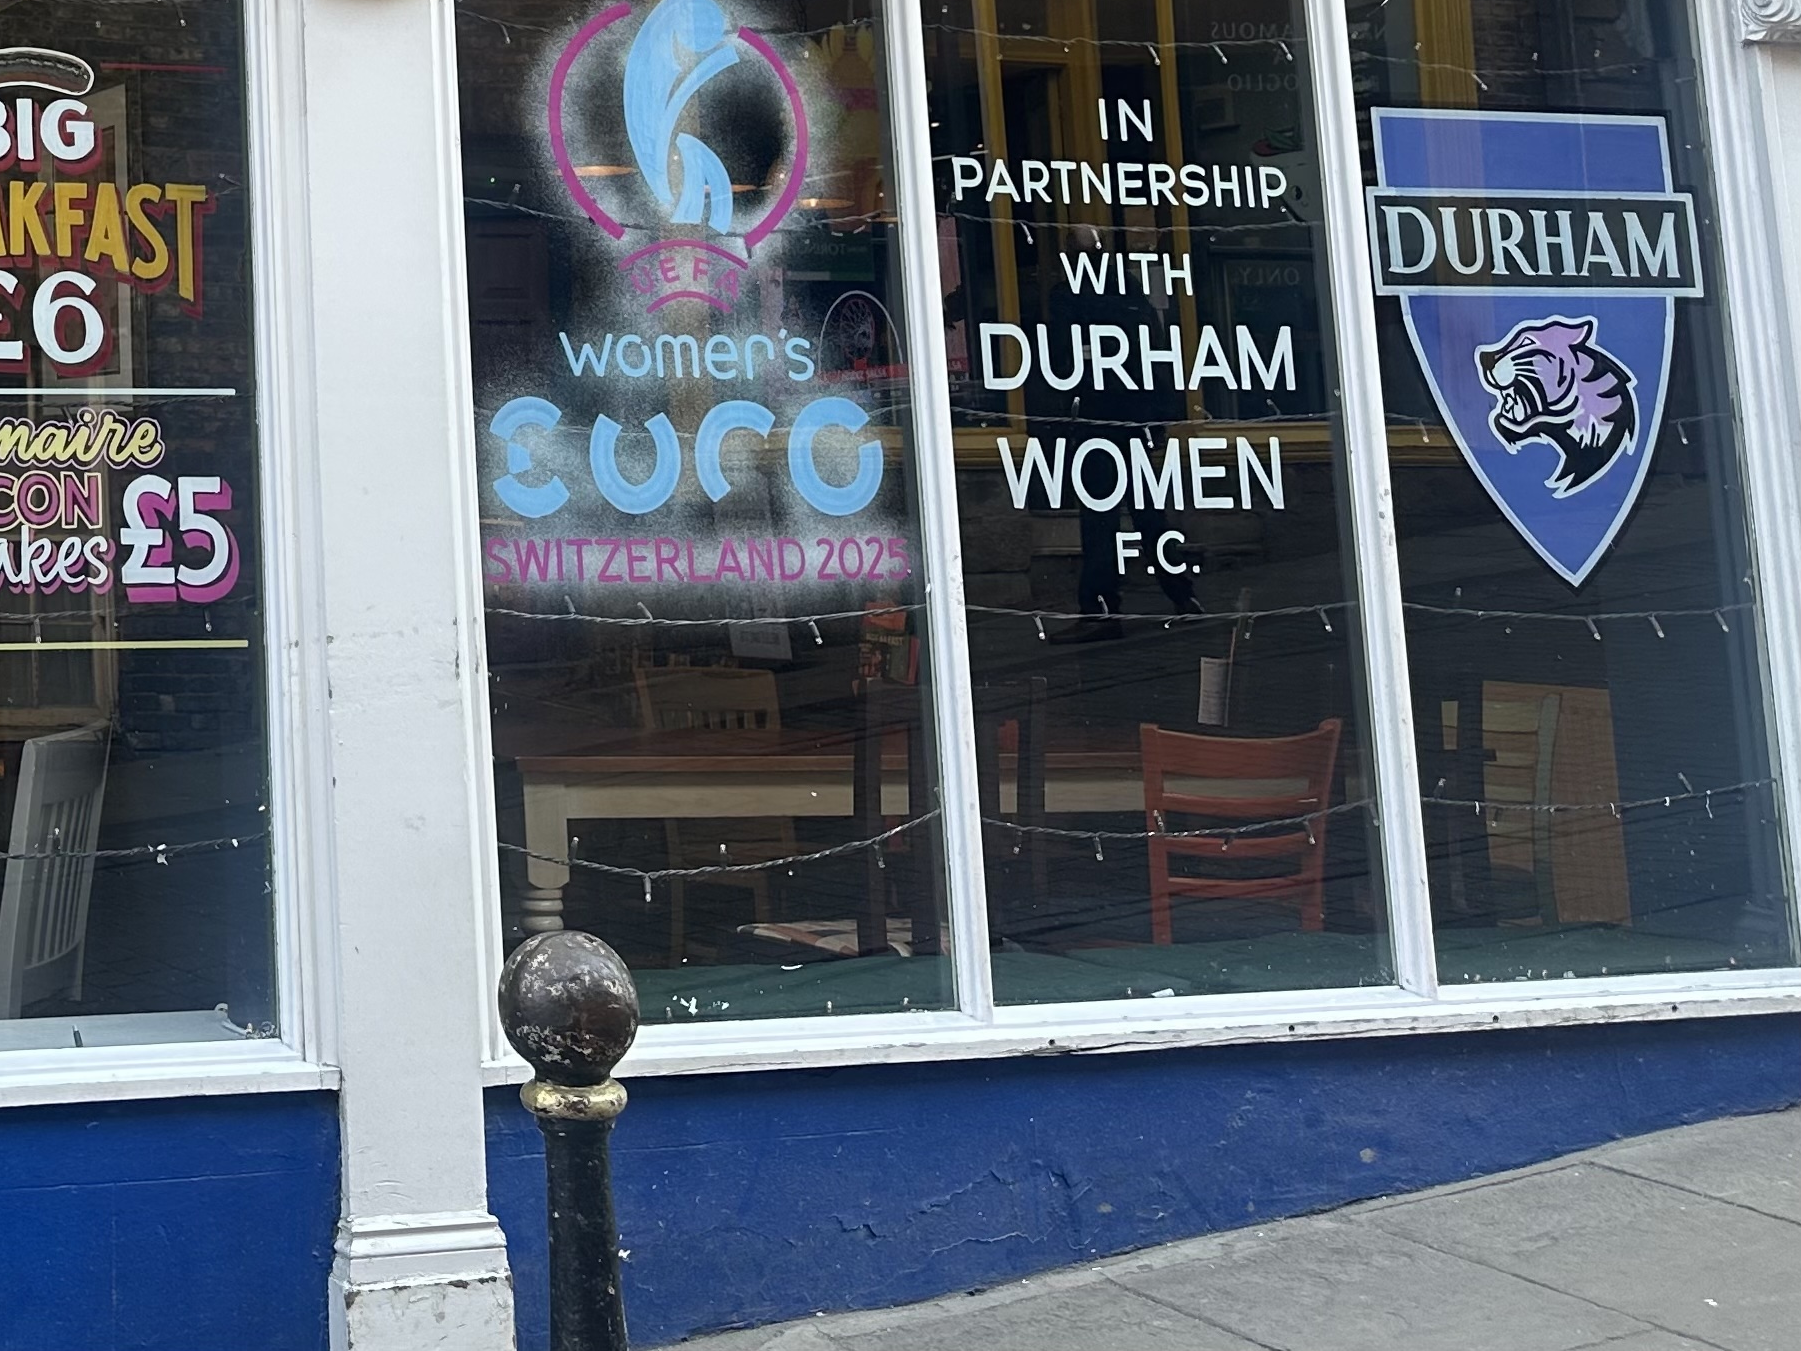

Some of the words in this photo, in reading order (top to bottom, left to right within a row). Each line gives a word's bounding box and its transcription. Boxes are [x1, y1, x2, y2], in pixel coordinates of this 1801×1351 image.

[1097, 98, 1153, 142] IN
[951, 156, 1288, 209] PARTNERSHIP
[1379, 205, 1681, 279] DURHAM
[629, 256, 739, 301] UEFA
[1059, 251, 1194, 296] WITH
[558, 327, 815, 381] women's
[978, 322, 1297, 392] DURHAM
[996, 436, 1286, 512] WOMEN
[120, 474, 233, 593] £5
[485, 537, 806, 583] SWITZERLAND
[815, 536, 909, 581] 2025
[1115, 530, 1201, 576] F.C.
